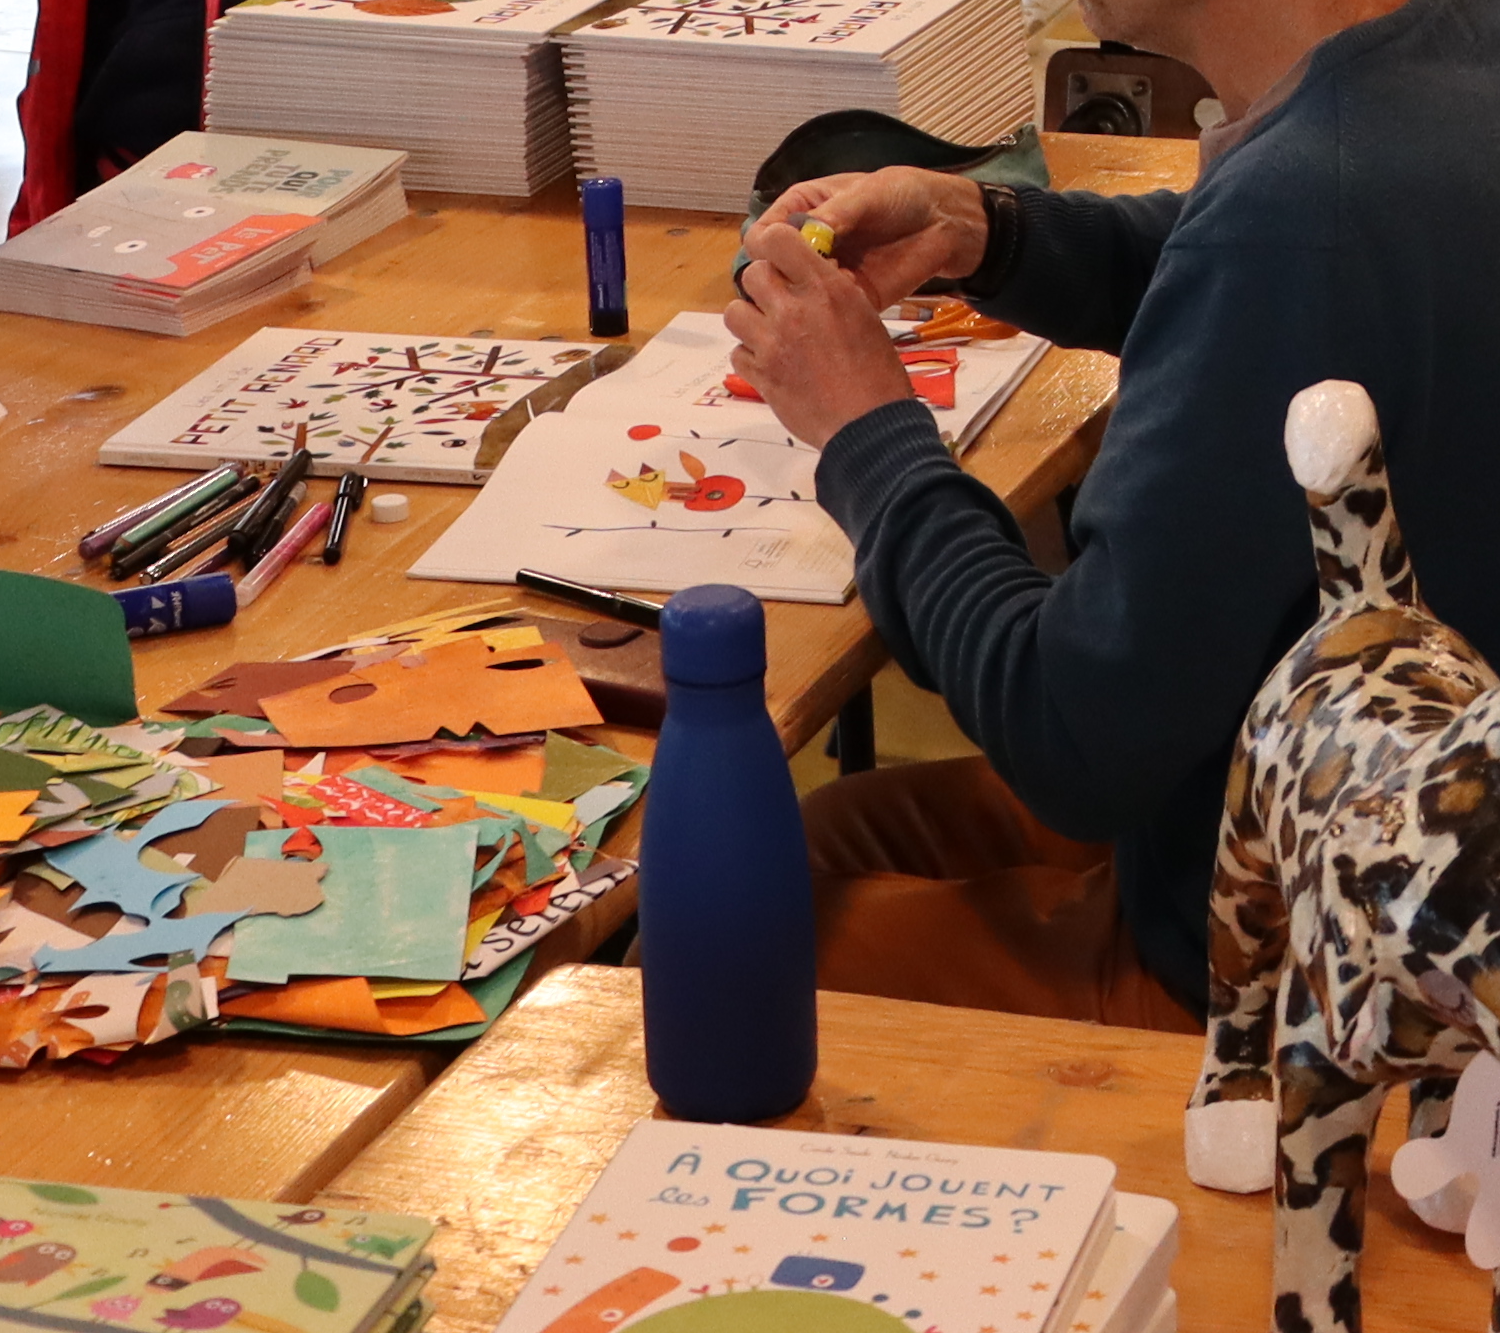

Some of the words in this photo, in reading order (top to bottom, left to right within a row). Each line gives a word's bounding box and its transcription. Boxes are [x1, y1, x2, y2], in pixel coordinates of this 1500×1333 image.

[808, 0, 902, 44] RENARD
[241, 336, 344, 394] RENARD
[648, 1186, 711, 1205] les
[730, 1186, 993, 1229] FORMES
[870, 1170, 1067, 1203] JOUENT
